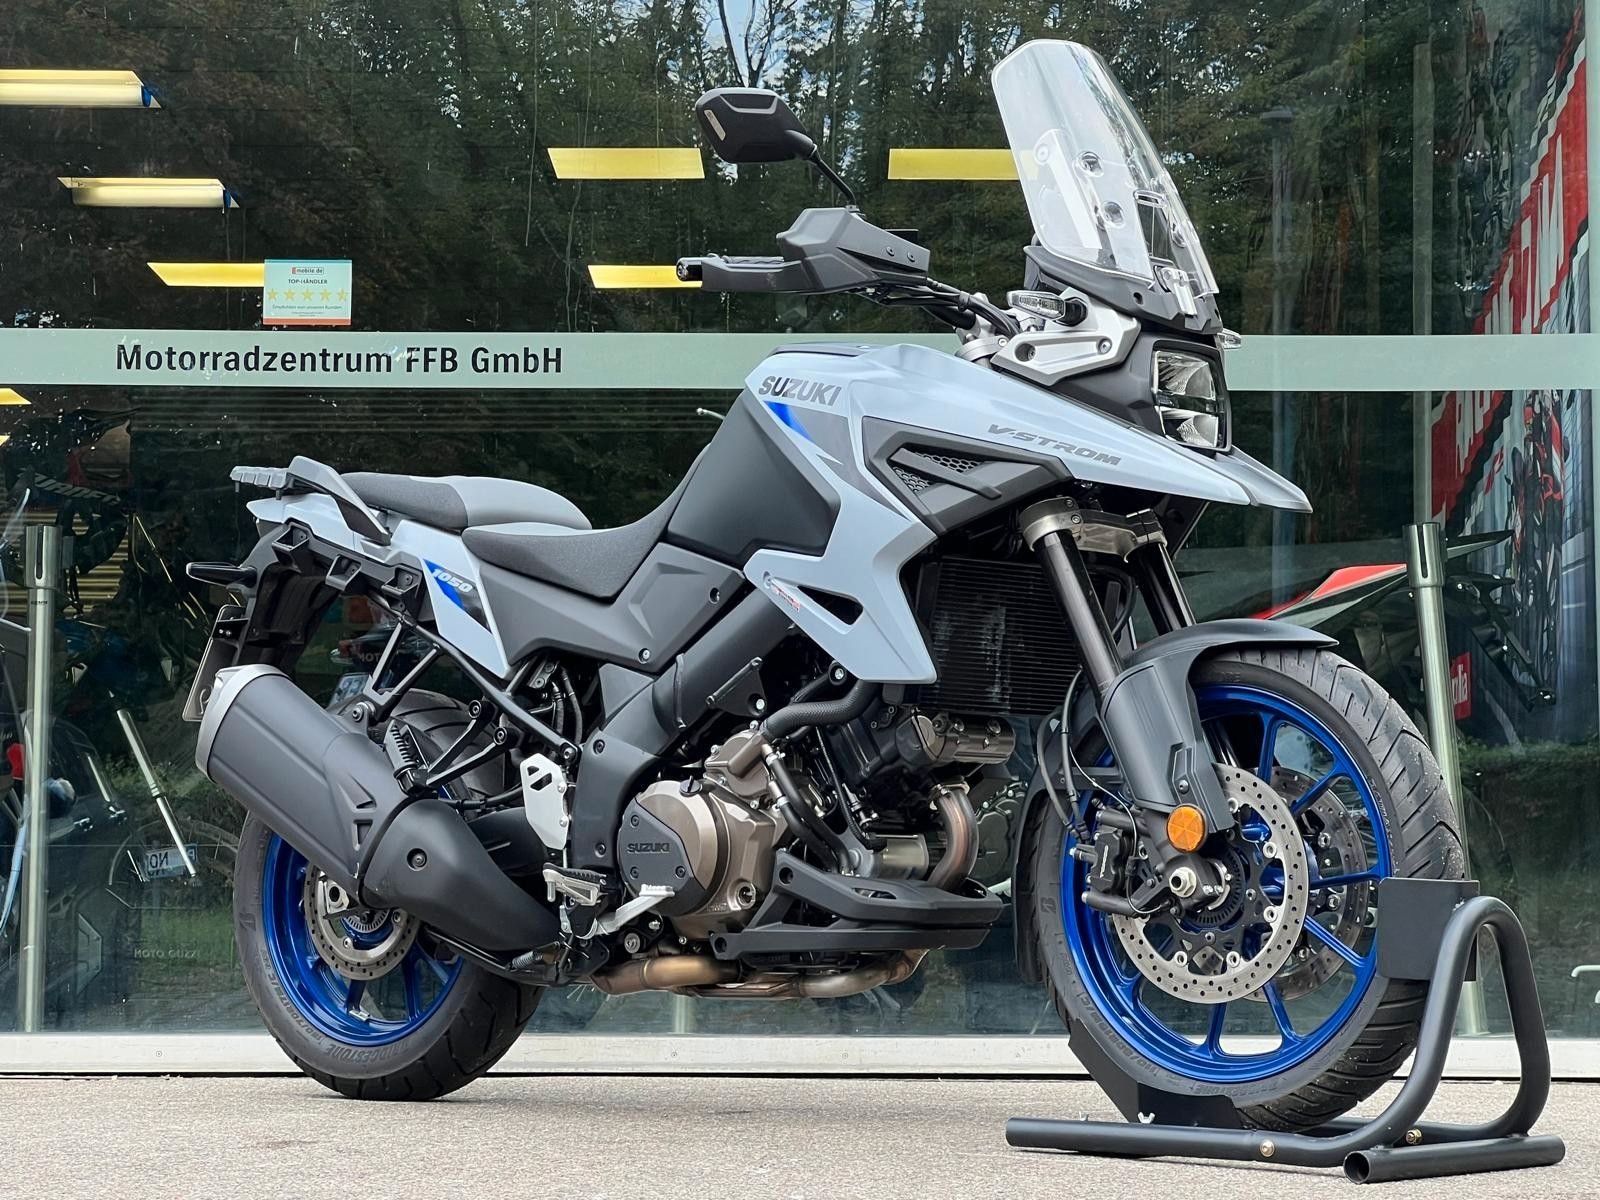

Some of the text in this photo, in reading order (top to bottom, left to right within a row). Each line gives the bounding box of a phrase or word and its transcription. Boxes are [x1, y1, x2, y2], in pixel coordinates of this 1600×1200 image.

[116, 344, 562, 373] Motorradzentrum FFB GmbH
[758, 375, 842, 407] SUZUKI
[432, 568, 473, 593] 1050
[626, 842, 670, 854] SUZUKI
